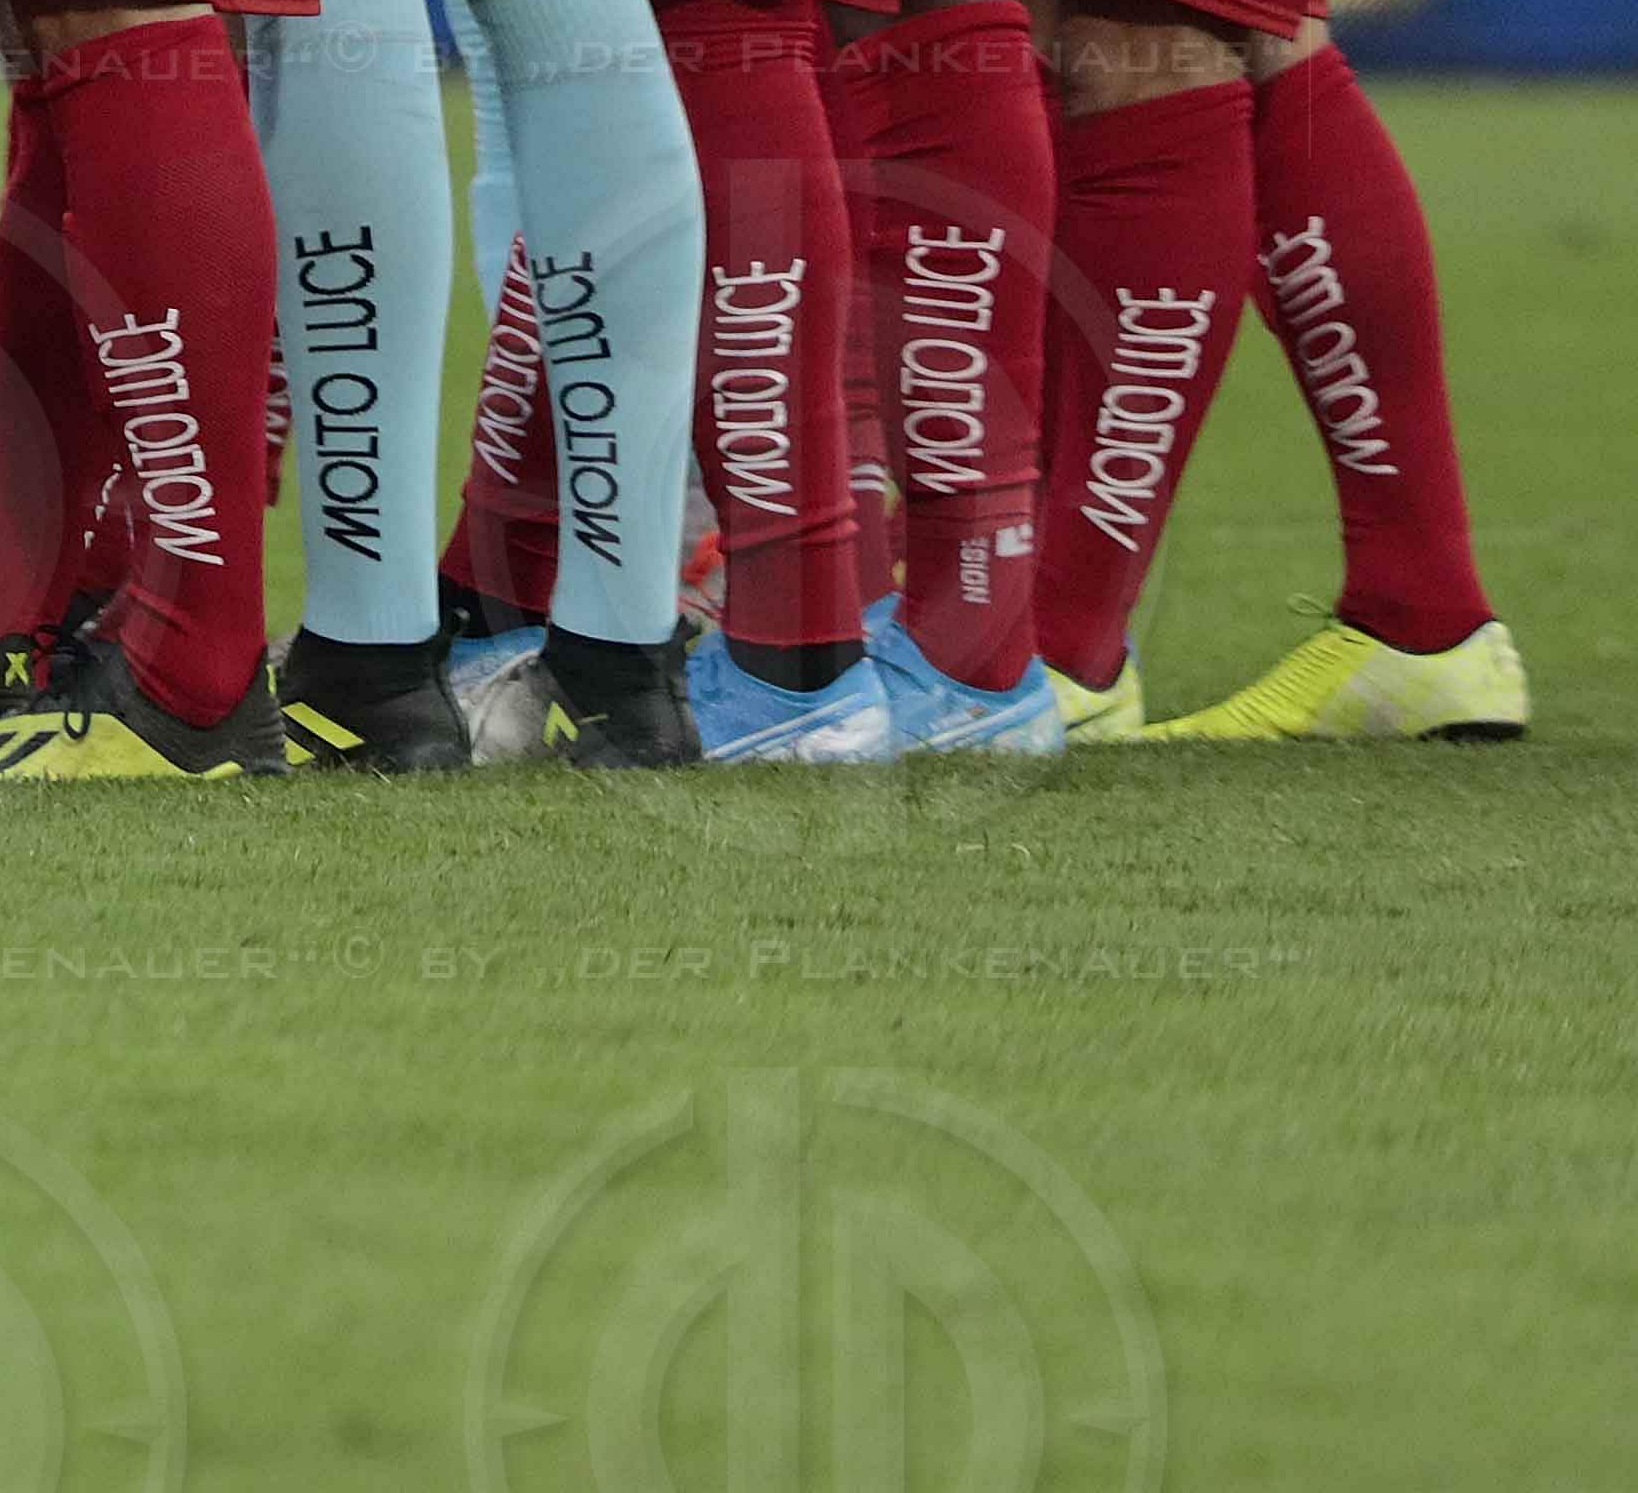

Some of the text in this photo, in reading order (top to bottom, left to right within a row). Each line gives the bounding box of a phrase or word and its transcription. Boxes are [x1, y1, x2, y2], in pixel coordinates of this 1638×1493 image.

[88, 307, 226, 567] MOLTO LUCE
[294, 225, 383, 563] MOLTO LUCE
[532, 249, 626, 569] MOLTO LUCE
[712, 257, 807, 516] MOLTO LUCE
[900, 224, 1007, 495] MOLTO LUCE
[1081, 288, 1216, 553] MOLTO LUCE
